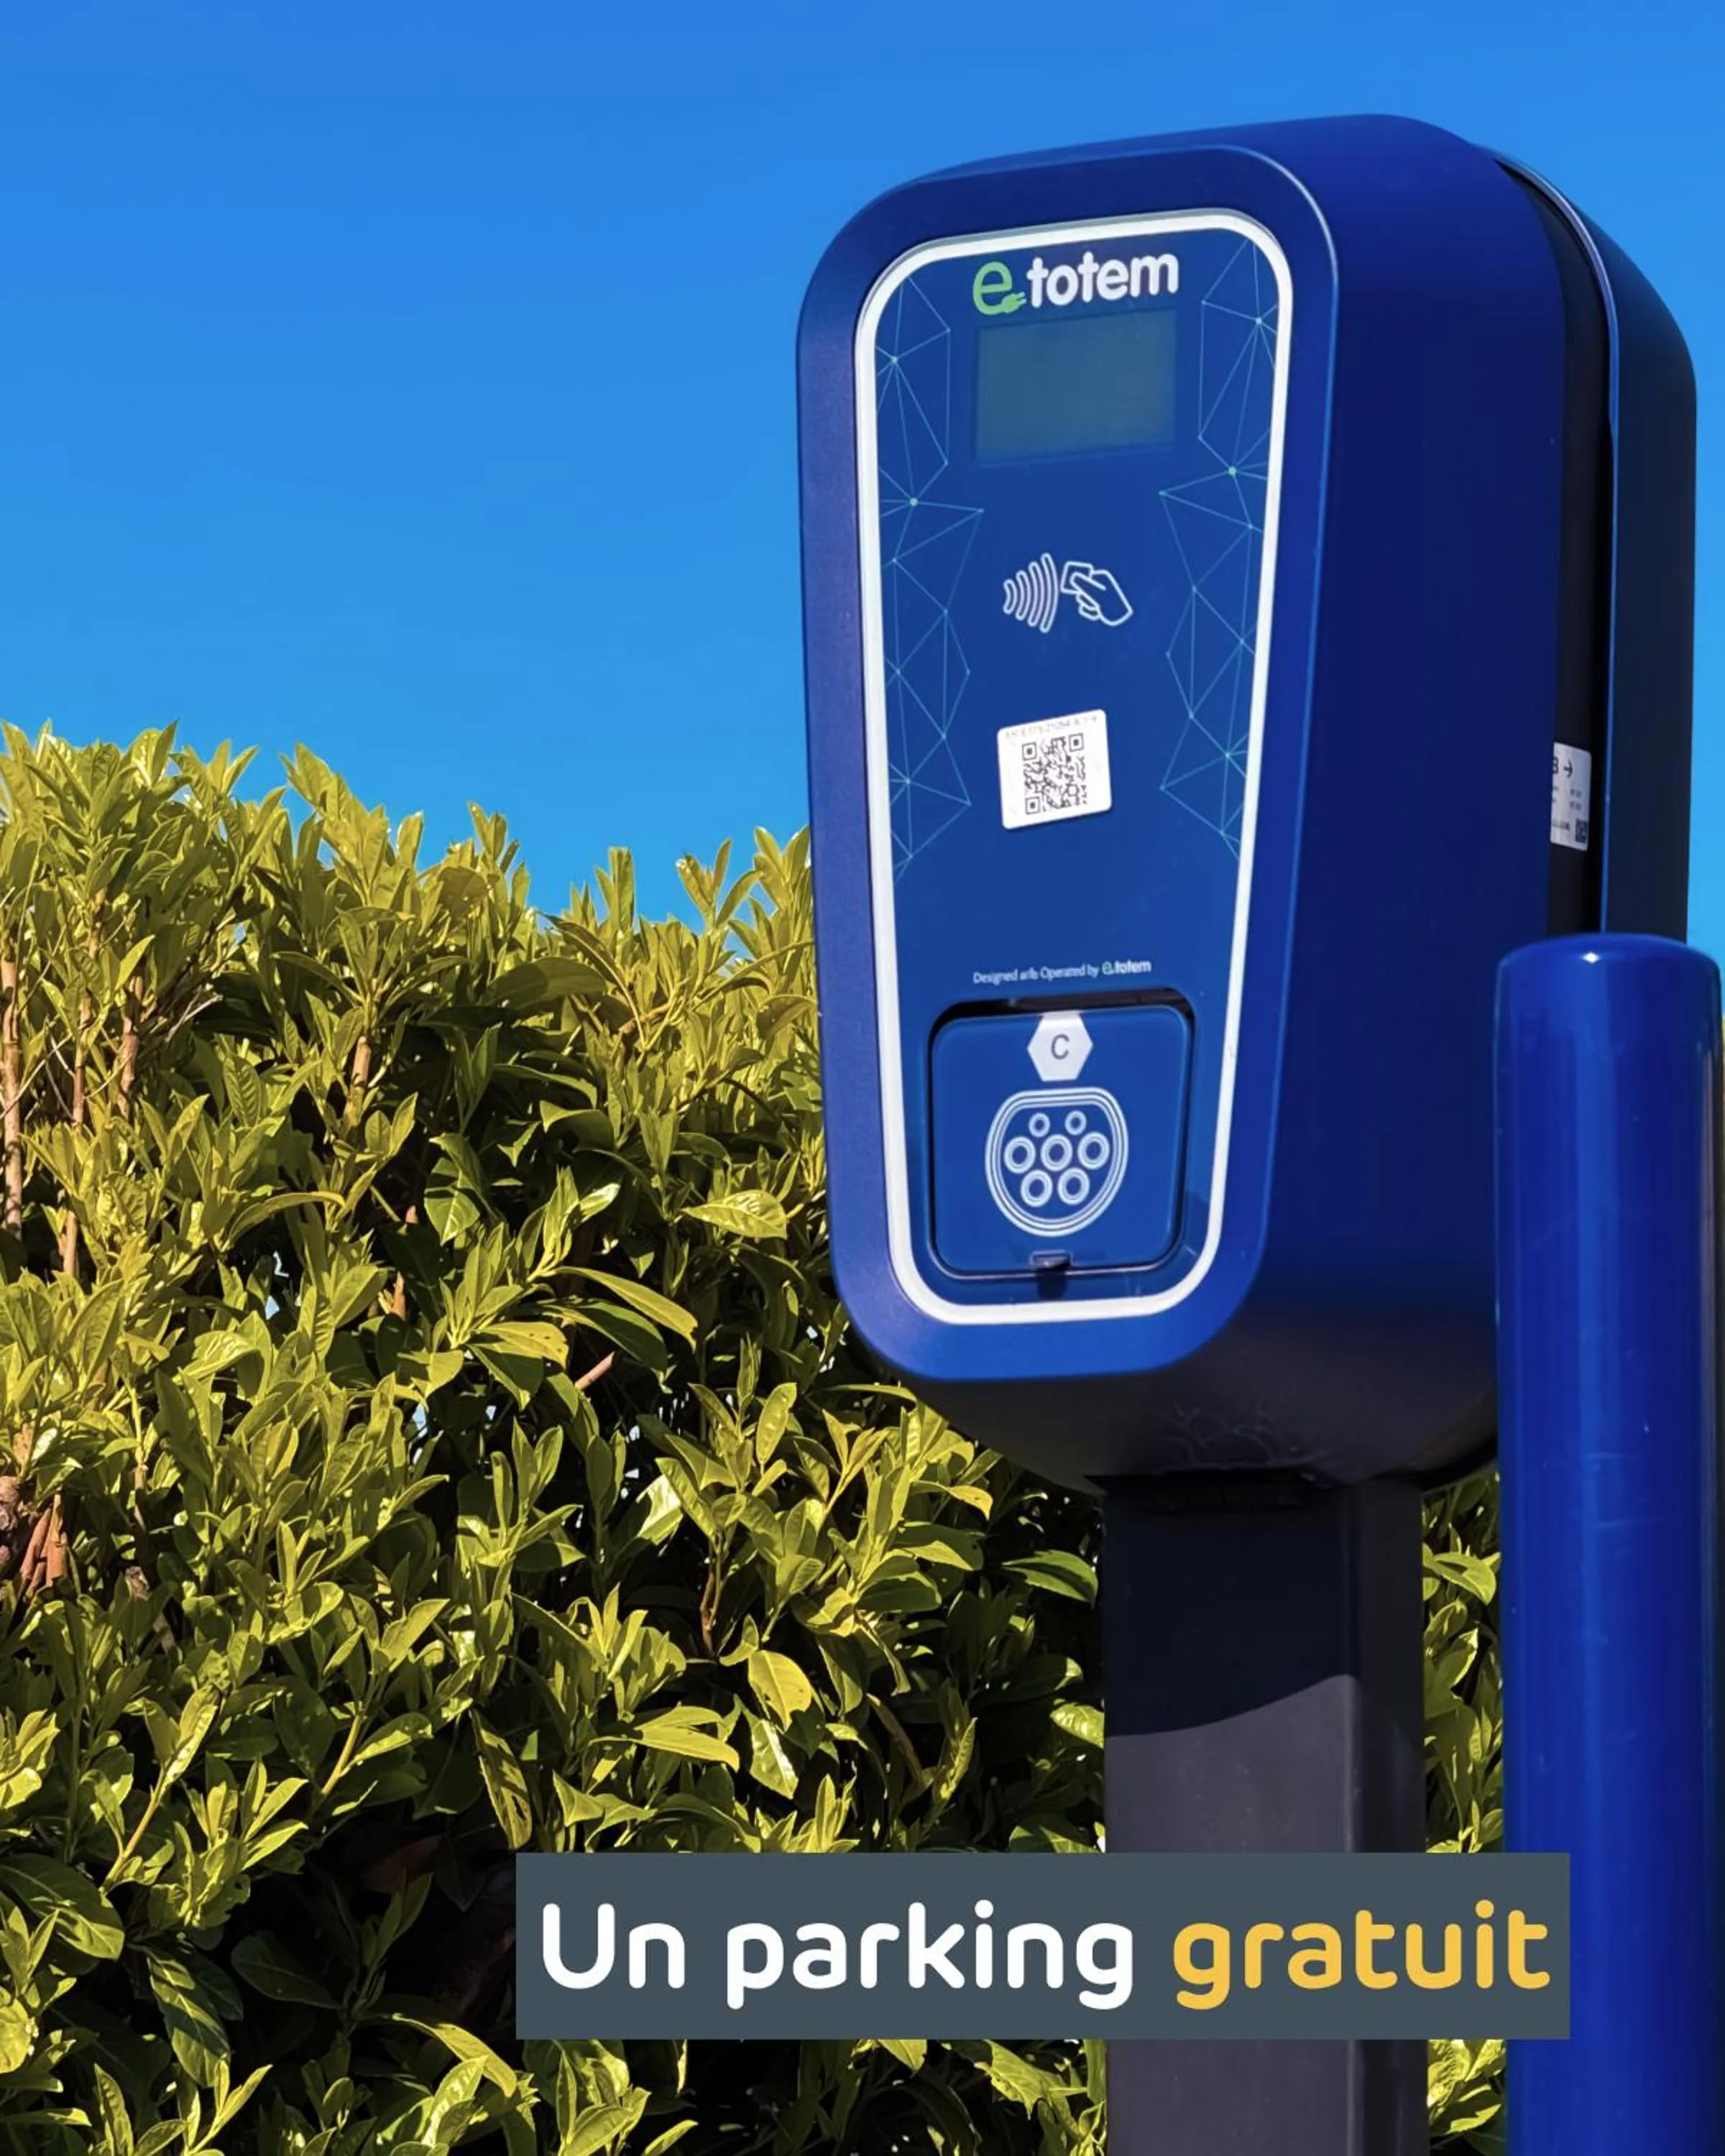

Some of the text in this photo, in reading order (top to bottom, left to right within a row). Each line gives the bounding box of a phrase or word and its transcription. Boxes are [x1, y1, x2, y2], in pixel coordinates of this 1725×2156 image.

[973, 969, 1017, 985] Designed
[1040, 964, 1085, 982] Operated
[1087, 964, 1100, 978] by
[1051, 1033, 1070, 1060] C
